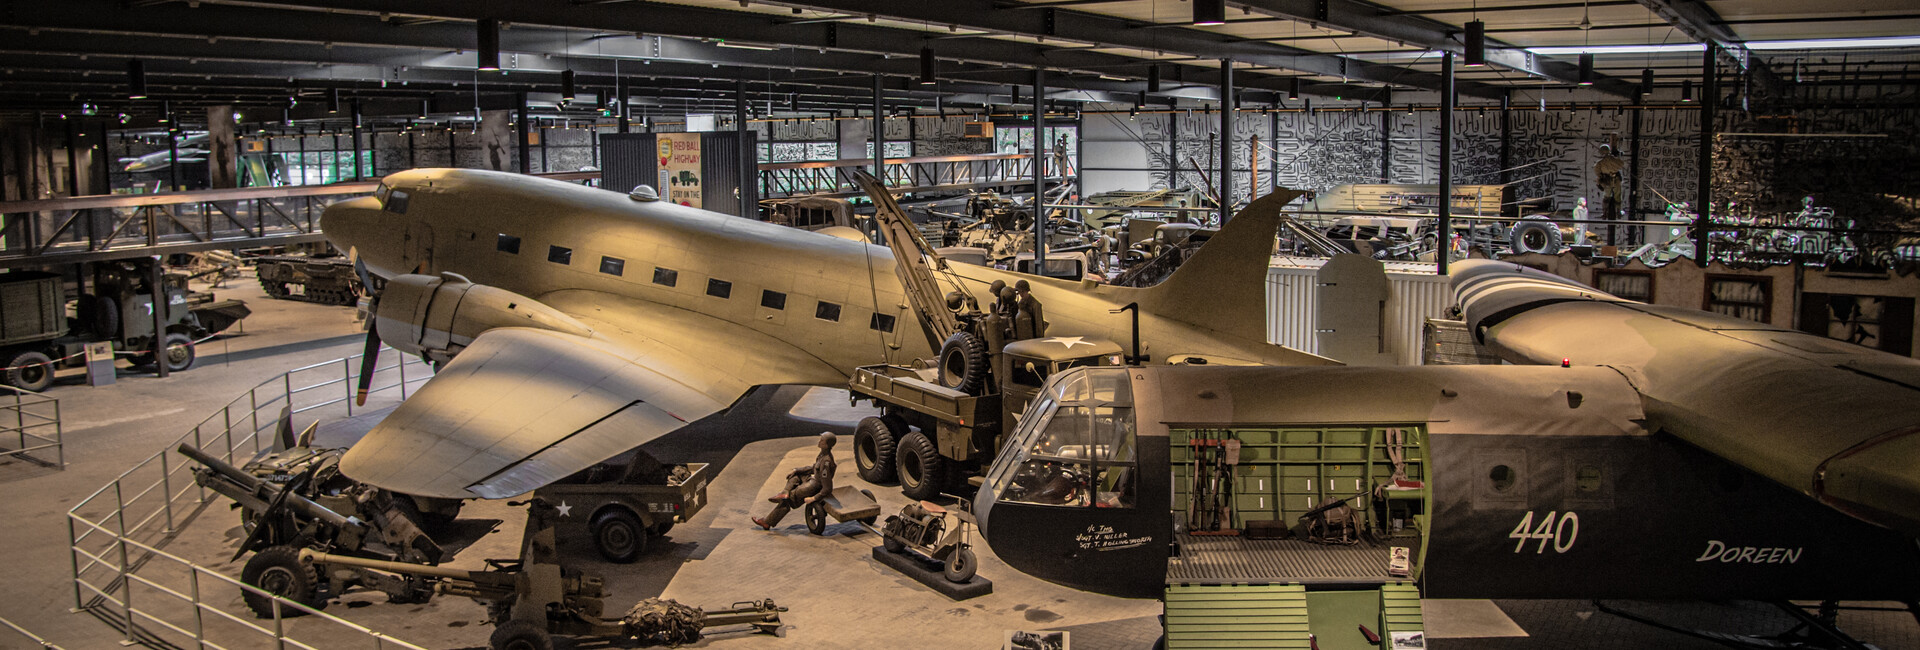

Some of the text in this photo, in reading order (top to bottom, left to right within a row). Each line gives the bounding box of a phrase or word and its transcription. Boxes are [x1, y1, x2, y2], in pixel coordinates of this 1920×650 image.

[674, 141, 686, 151] RED
[687, 141, 700, 151] BALL
[674, 154, 700, 164] HIGHWAY
[673, 190, 700, 199] STAY ON THE
[1509, 511, 1579, 554] 440
[1696, 540, 1802, 564] DOREEN
